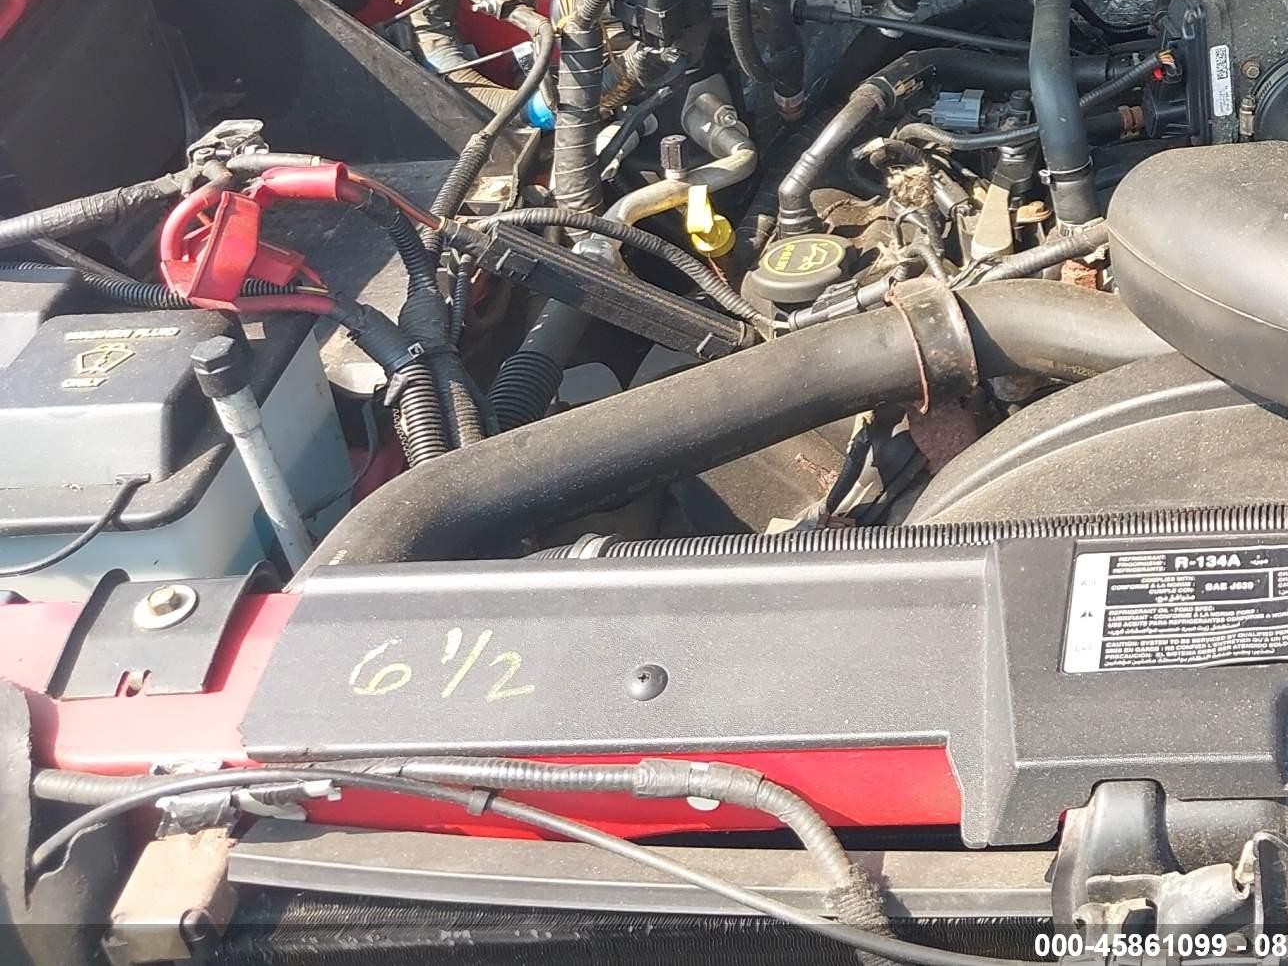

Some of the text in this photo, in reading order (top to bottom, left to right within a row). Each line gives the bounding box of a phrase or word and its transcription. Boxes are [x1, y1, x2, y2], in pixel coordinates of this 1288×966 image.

[1174, 554, 1241, 570] R-134A
[1205, 582, 1228, 591] SAE
[349, 638, 412, 695] 6
